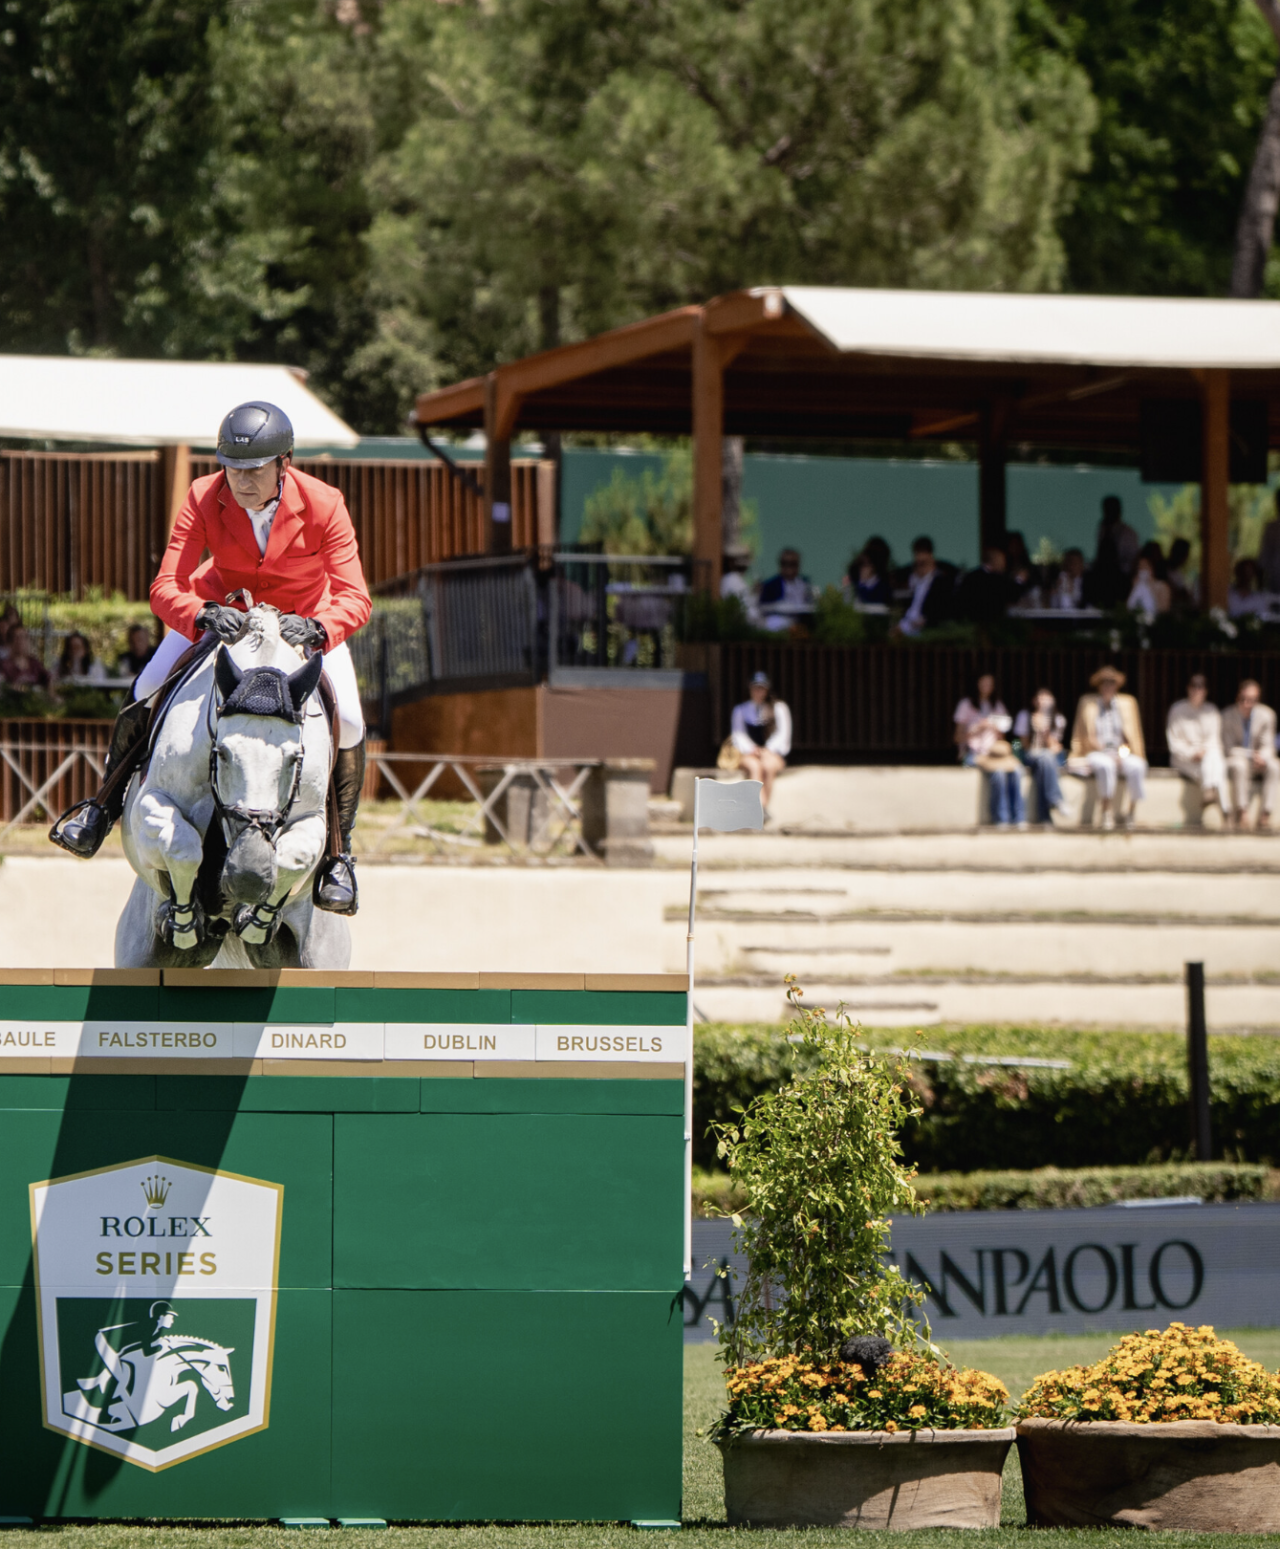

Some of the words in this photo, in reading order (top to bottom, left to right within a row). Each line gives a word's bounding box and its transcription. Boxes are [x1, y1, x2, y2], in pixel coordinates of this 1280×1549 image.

[98, 1031, 218, 1048] FALSTERBO
[271, 1032, 347, 1049] DINARD
[423, 1033, 497, 1051] DUBLIN
[556, 1035, 663, 1053] BRUSSELS
[99, 1215, 213, 1238] ROLEX
[95, 1251, 218, 1276] SERIES
[878, 1239, 1206, 1319] ANPAOLO
